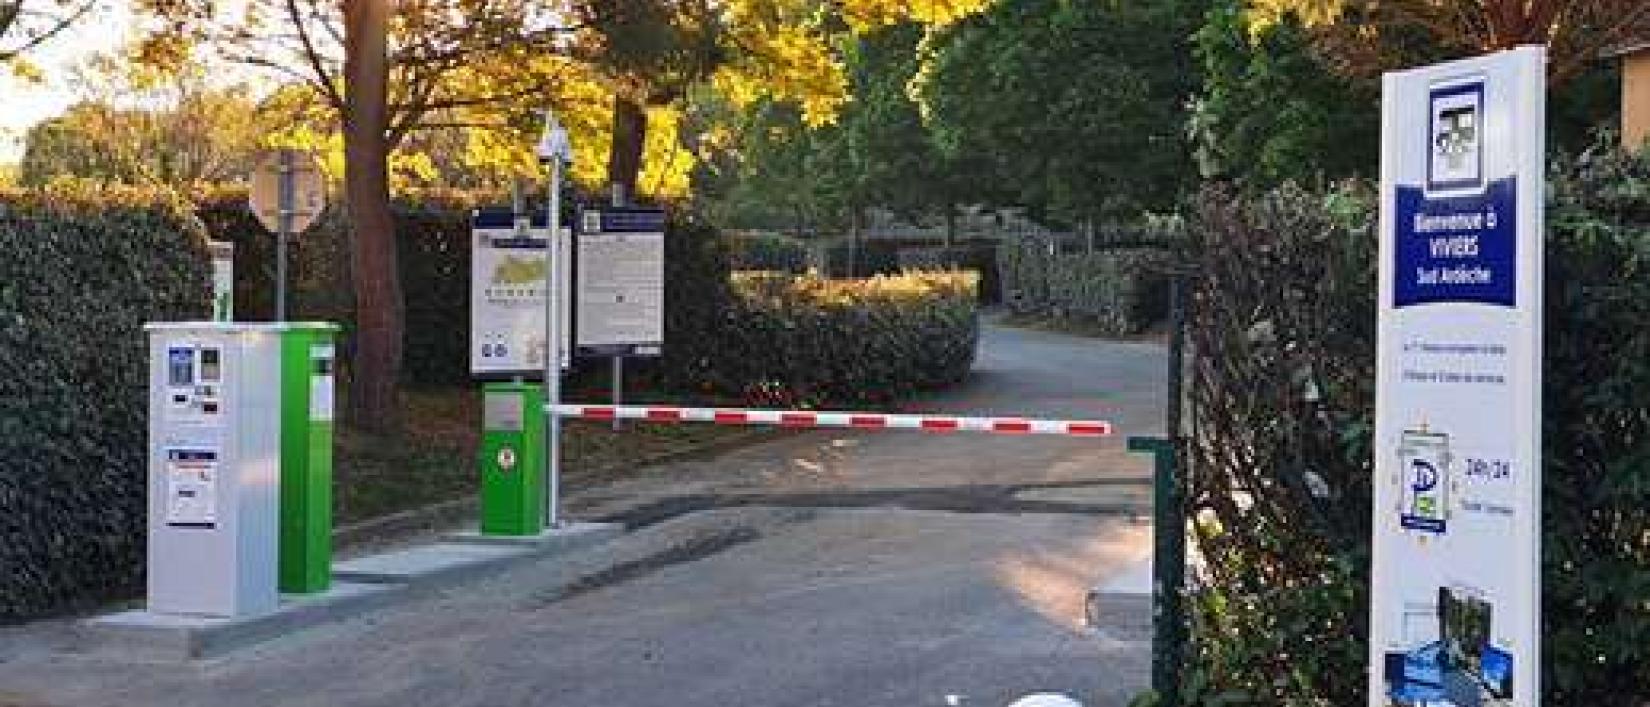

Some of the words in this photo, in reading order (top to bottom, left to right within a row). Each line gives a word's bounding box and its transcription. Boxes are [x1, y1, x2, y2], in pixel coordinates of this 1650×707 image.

[1413, 211, 1481, 232] Bienvenue
[1429, 235, 1478, 258] VIVIERS
[1416, 266, 1439, 286] Sud
[1441, 263, 1491, 285] Ardèche
